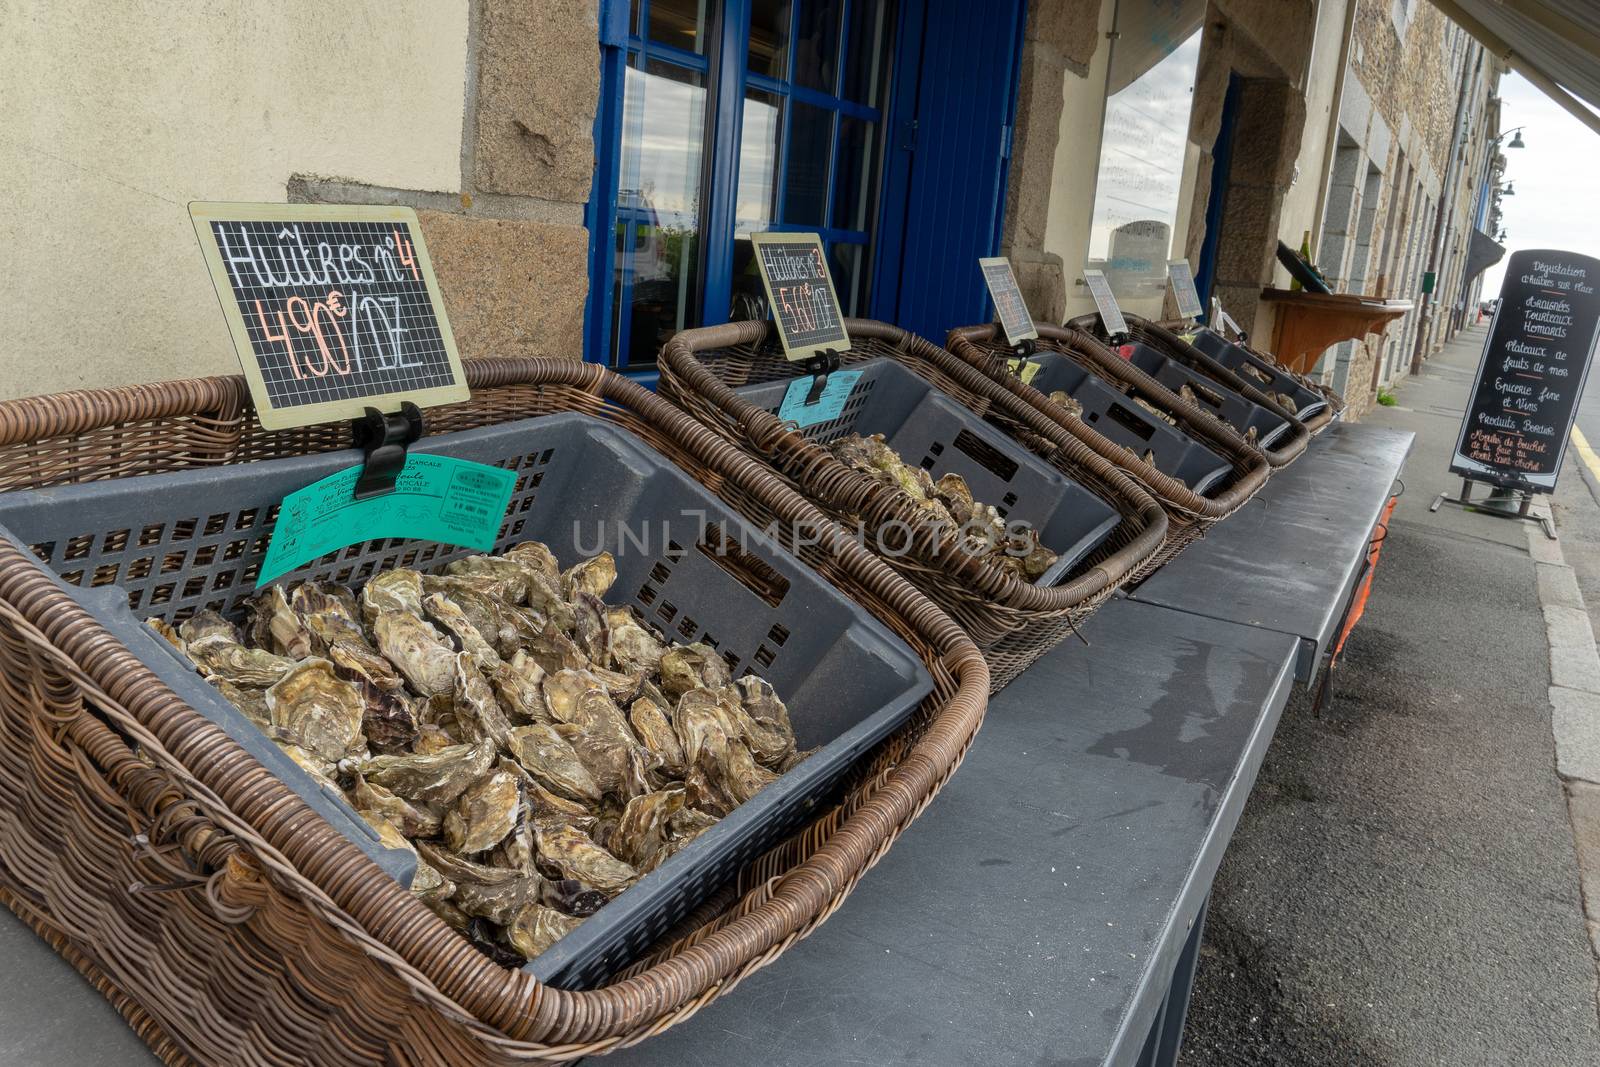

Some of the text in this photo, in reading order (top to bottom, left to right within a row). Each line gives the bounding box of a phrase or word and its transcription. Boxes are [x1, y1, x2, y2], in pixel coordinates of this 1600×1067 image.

[1532, 260, 1586, 278] Dégustation
[1525, 296, 1570, 313] Araignées
[1524, 309, 1573, 326] Tourteaux
[1523, 320, 1567, 338] Homards
[1505, 340, 1567, 361] Plateaux de
[1503, 356, 1569, 377] fruits de mer
[1495, 377, 1560, 403] Epicerie fine
[1502, 397, 1538, 412] et Vins
[1478, 411, 1516, 429] Produits
[1504, 437, 1514, 447] de
